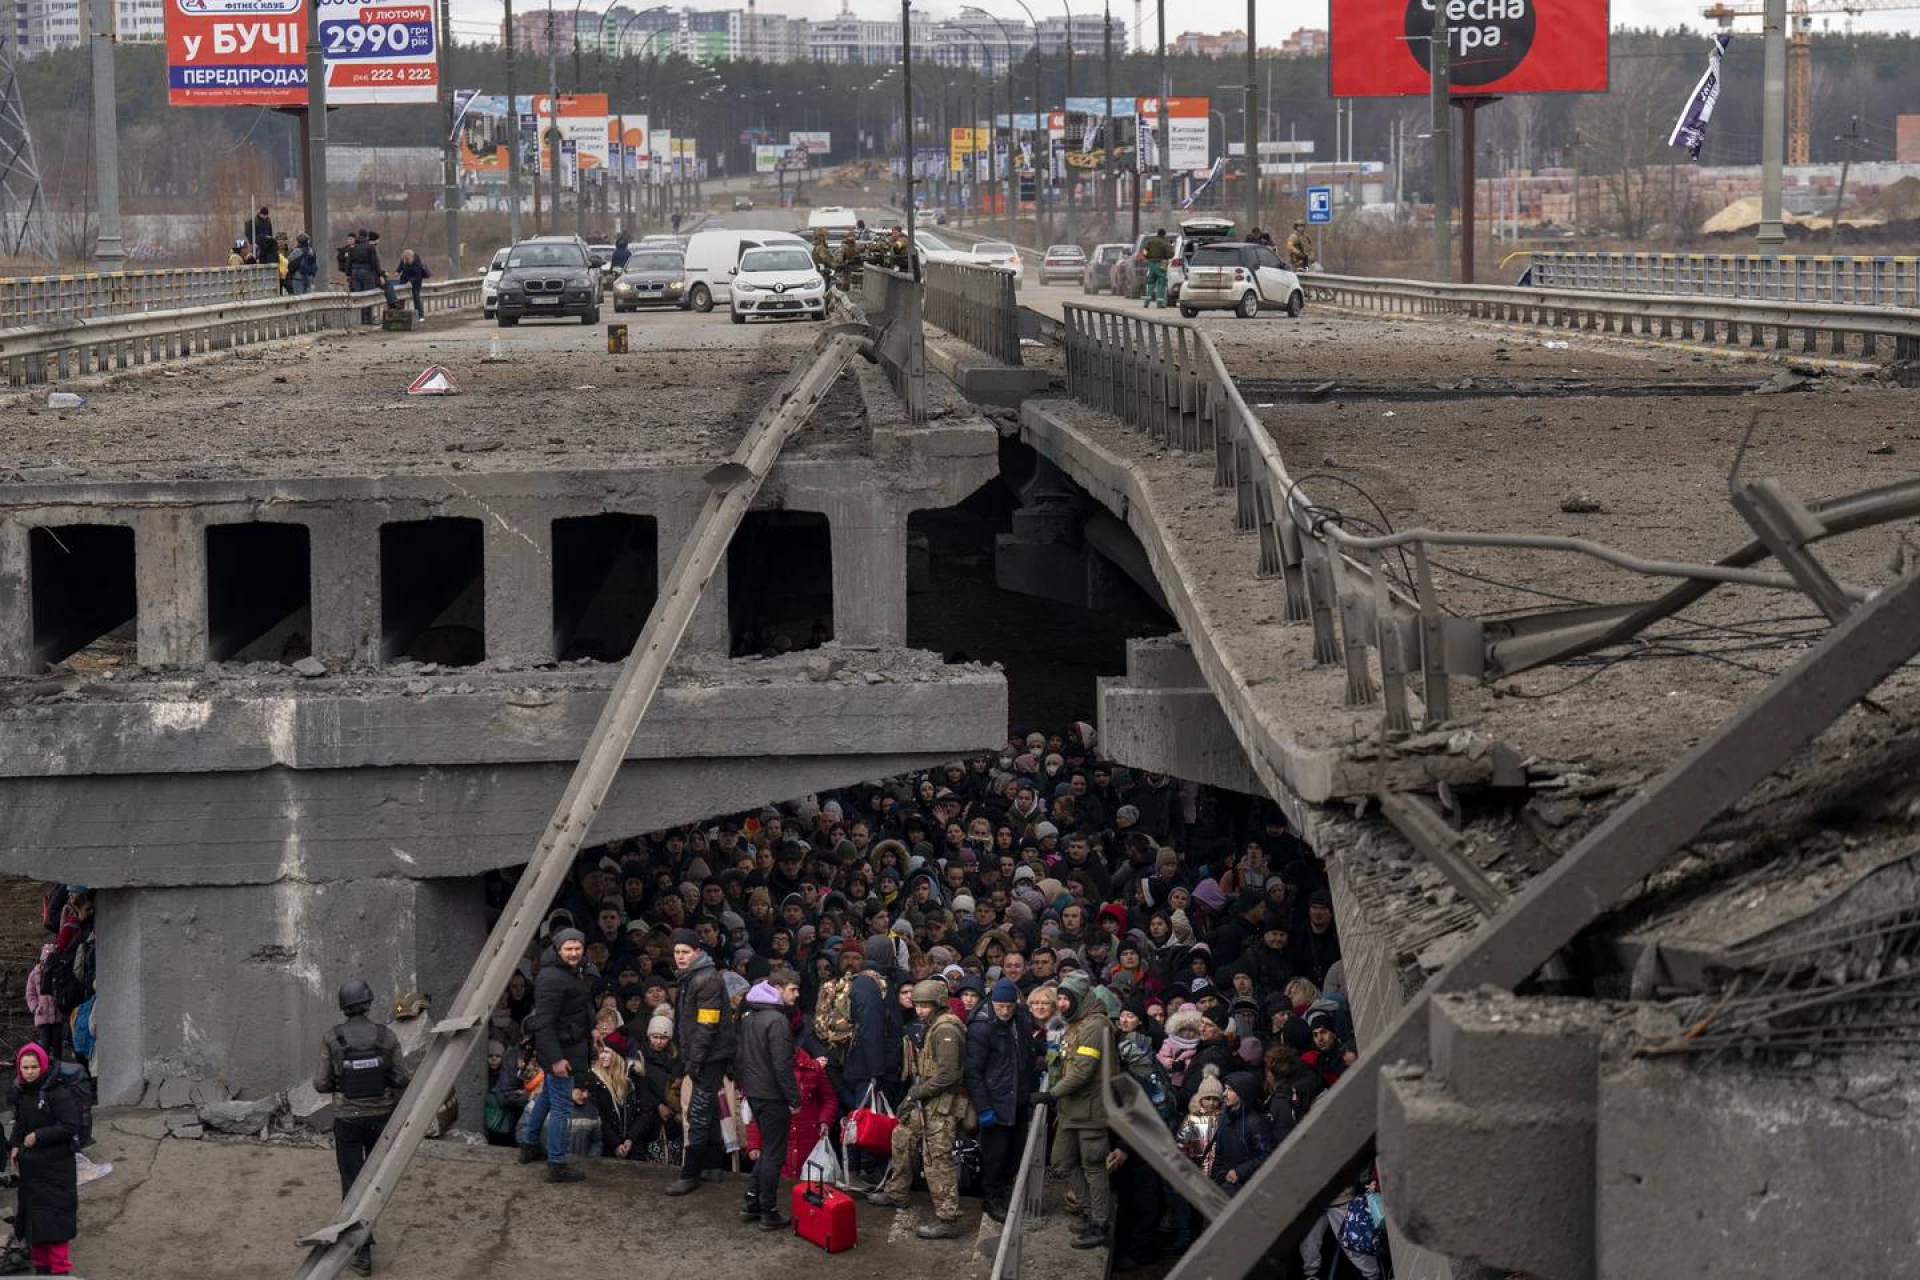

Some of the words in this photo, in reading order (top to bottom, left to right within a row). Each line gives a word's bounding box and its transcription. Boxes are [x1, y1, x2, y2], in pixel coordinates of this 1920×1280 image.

[366, 12, 374, 22] у
[376, 9, 427, 20] лютому
[410, 27, 429, 35] грн
[183, 36, 202, 61] у
[213, 23, 299, 54] БУЧІ
[327, 23, 410, 54] 2990
[411, 38, 429, 48] рік
[371, 69, 394, 81] 222
[396, 68, 405, 80] 4
[407, 67, 432, 80] 222
